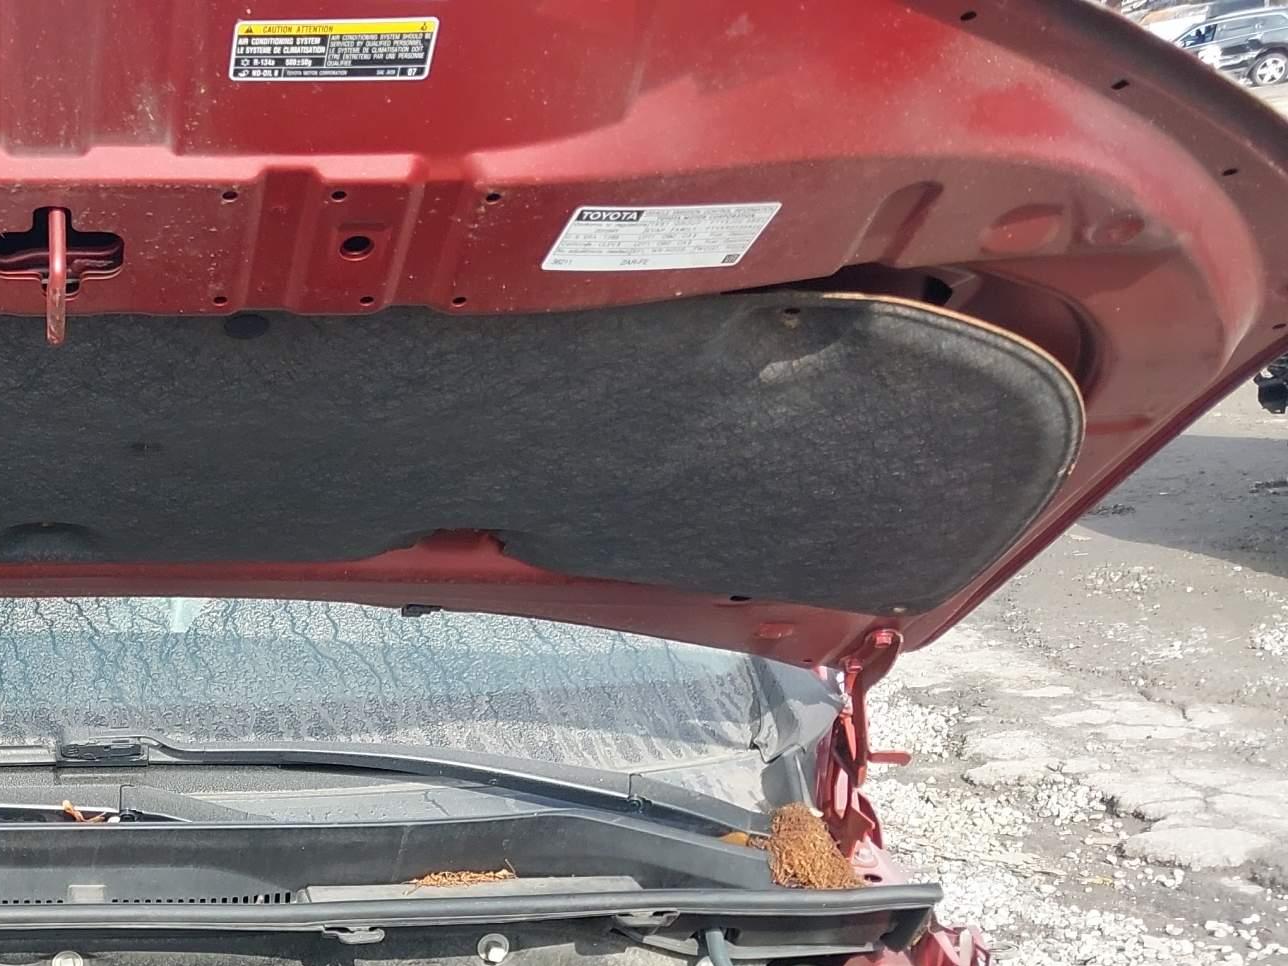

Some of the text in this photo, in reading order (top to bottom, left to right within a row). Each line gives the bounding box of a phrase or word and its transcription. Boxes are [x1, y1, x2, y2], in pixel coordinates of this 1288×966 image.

[263, 25, 334, 34] CAUTION ATTENTION
[238, 37, 321, 45] AIR CONDITIONING SYSTEM
[237, 46, 244, 54] LE
[273, 46, 282, 54] DE
[407, 68, 417, 77] 07
[581, 211, 638, 221] TOYOTA
